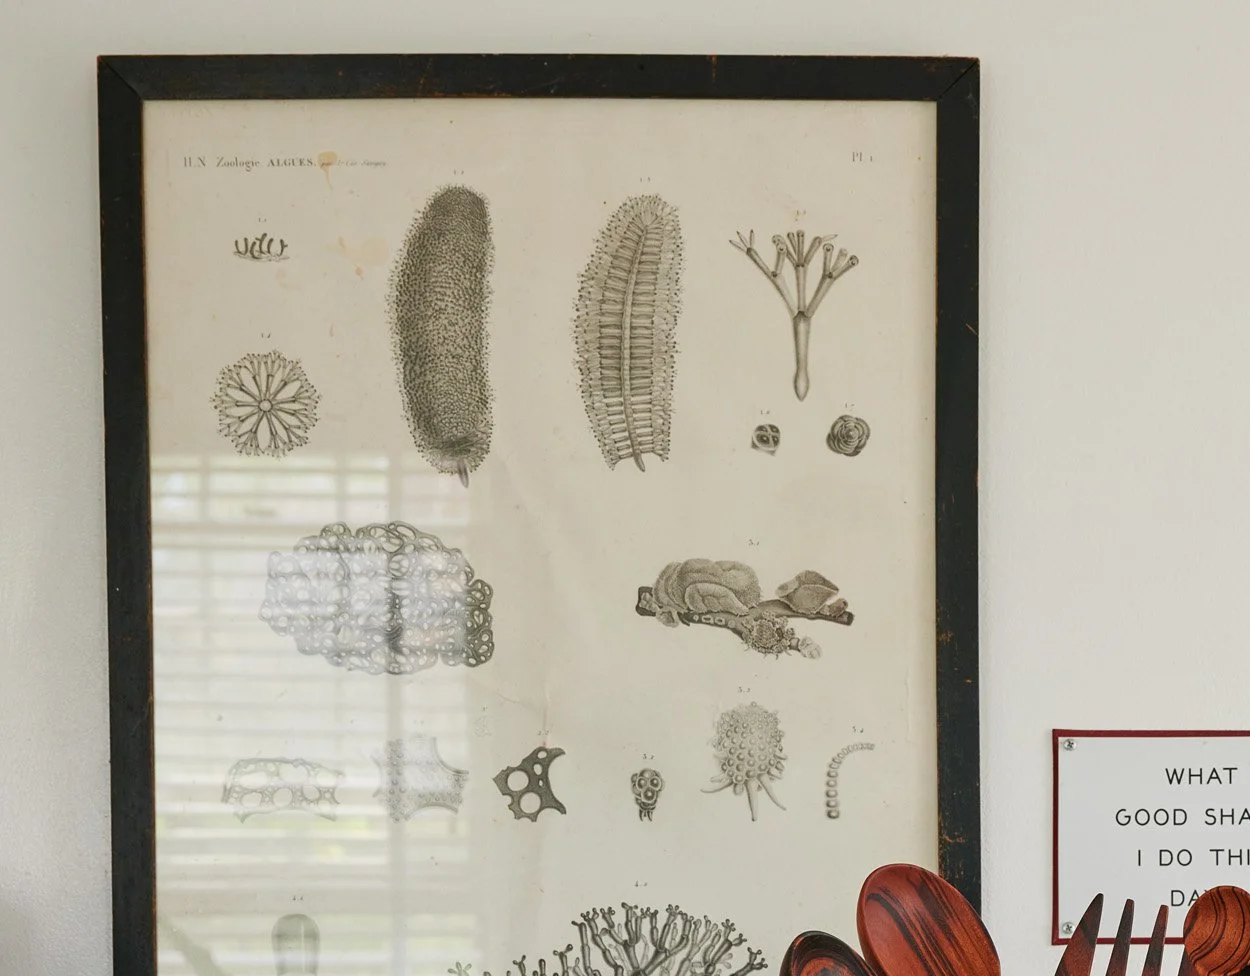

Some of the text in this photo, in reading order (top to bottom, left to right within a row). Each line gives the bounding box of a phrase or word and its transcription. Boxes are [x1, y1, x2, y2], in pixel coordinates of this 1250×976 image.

[1165, 767, 1238, 785] WHAT
[1115, 808, 1188, 826] GOOD
[1137, 849, 1141, 866] I
[1159, 849, 1193, 866] DO
[1170, 889, 1208, 906] DA
